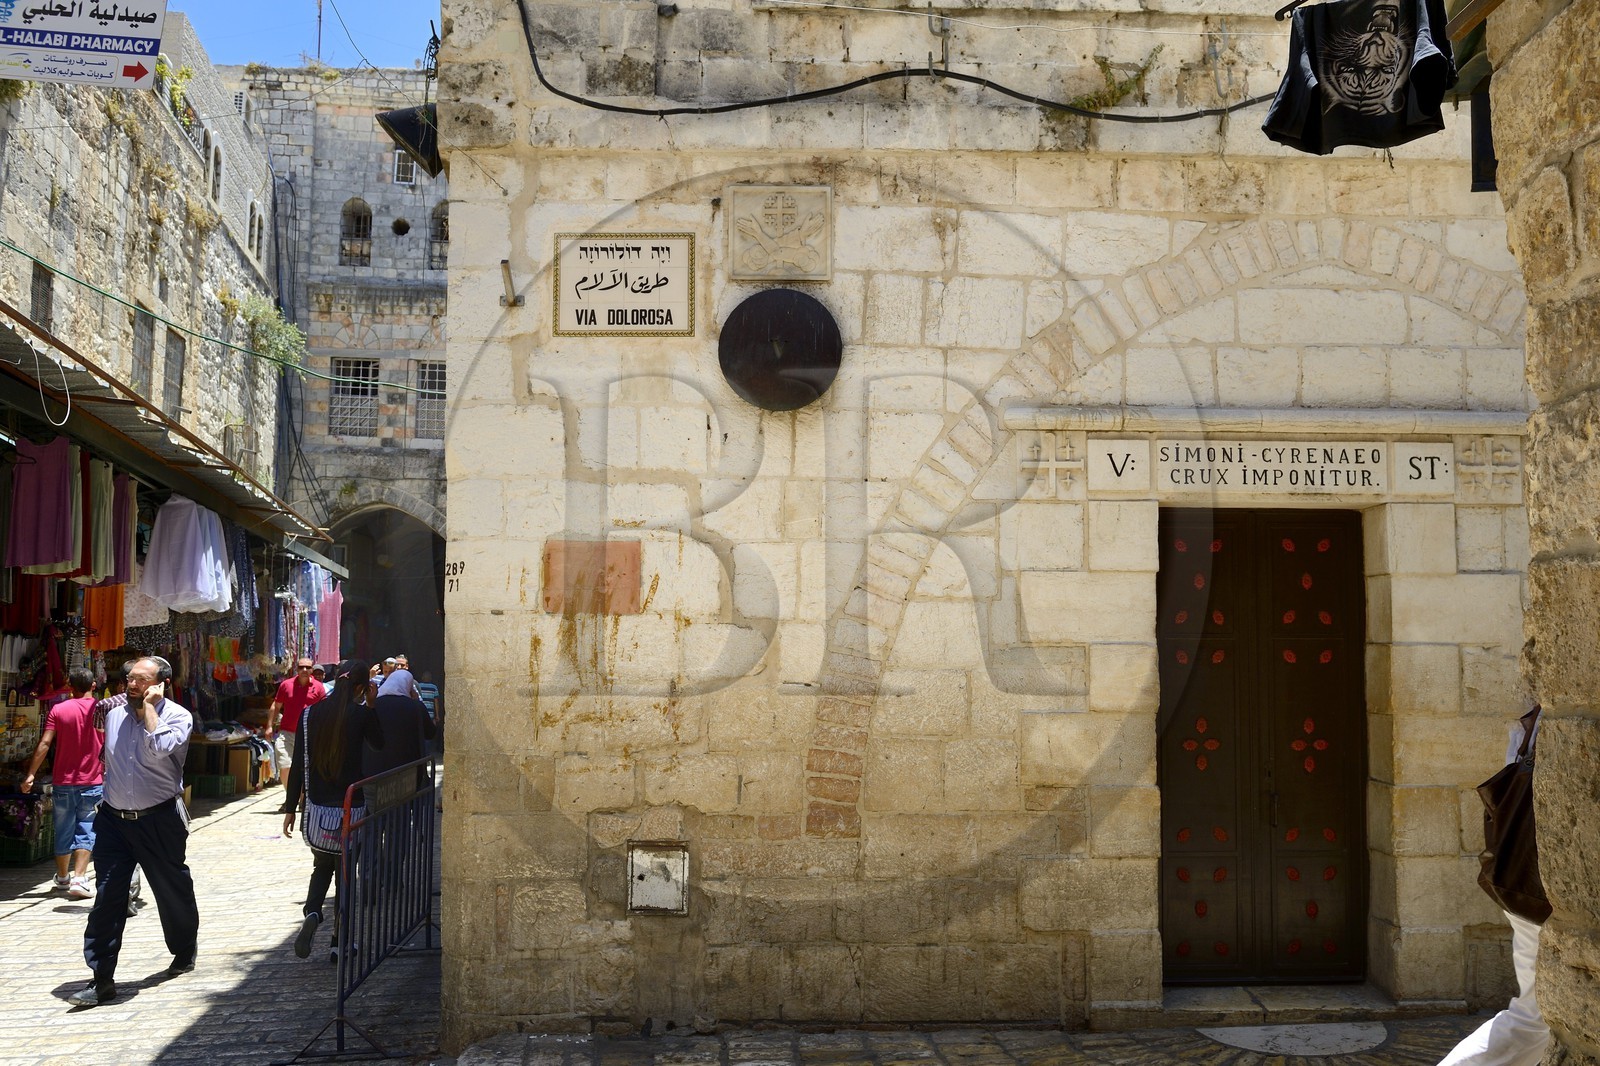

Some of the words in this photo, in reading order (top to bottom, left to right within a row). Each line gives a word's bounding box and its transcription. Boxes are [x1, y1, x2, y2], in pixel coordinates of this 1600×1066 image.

[22, 0, 83, 25] الحلبي
[89, 0, 158, 29] صيدلية
[70, 35, 154, 54] PHARMACY
[630, 272, 670, 294] طريق
[575, 308, 598, 326] VIA
[607, 308, 674, 326] DOLOROSA
[1169, 467, 1229, 486] CRUX
[445, 560, 465, 576] 289
[448, 578, 459, 593] 71
